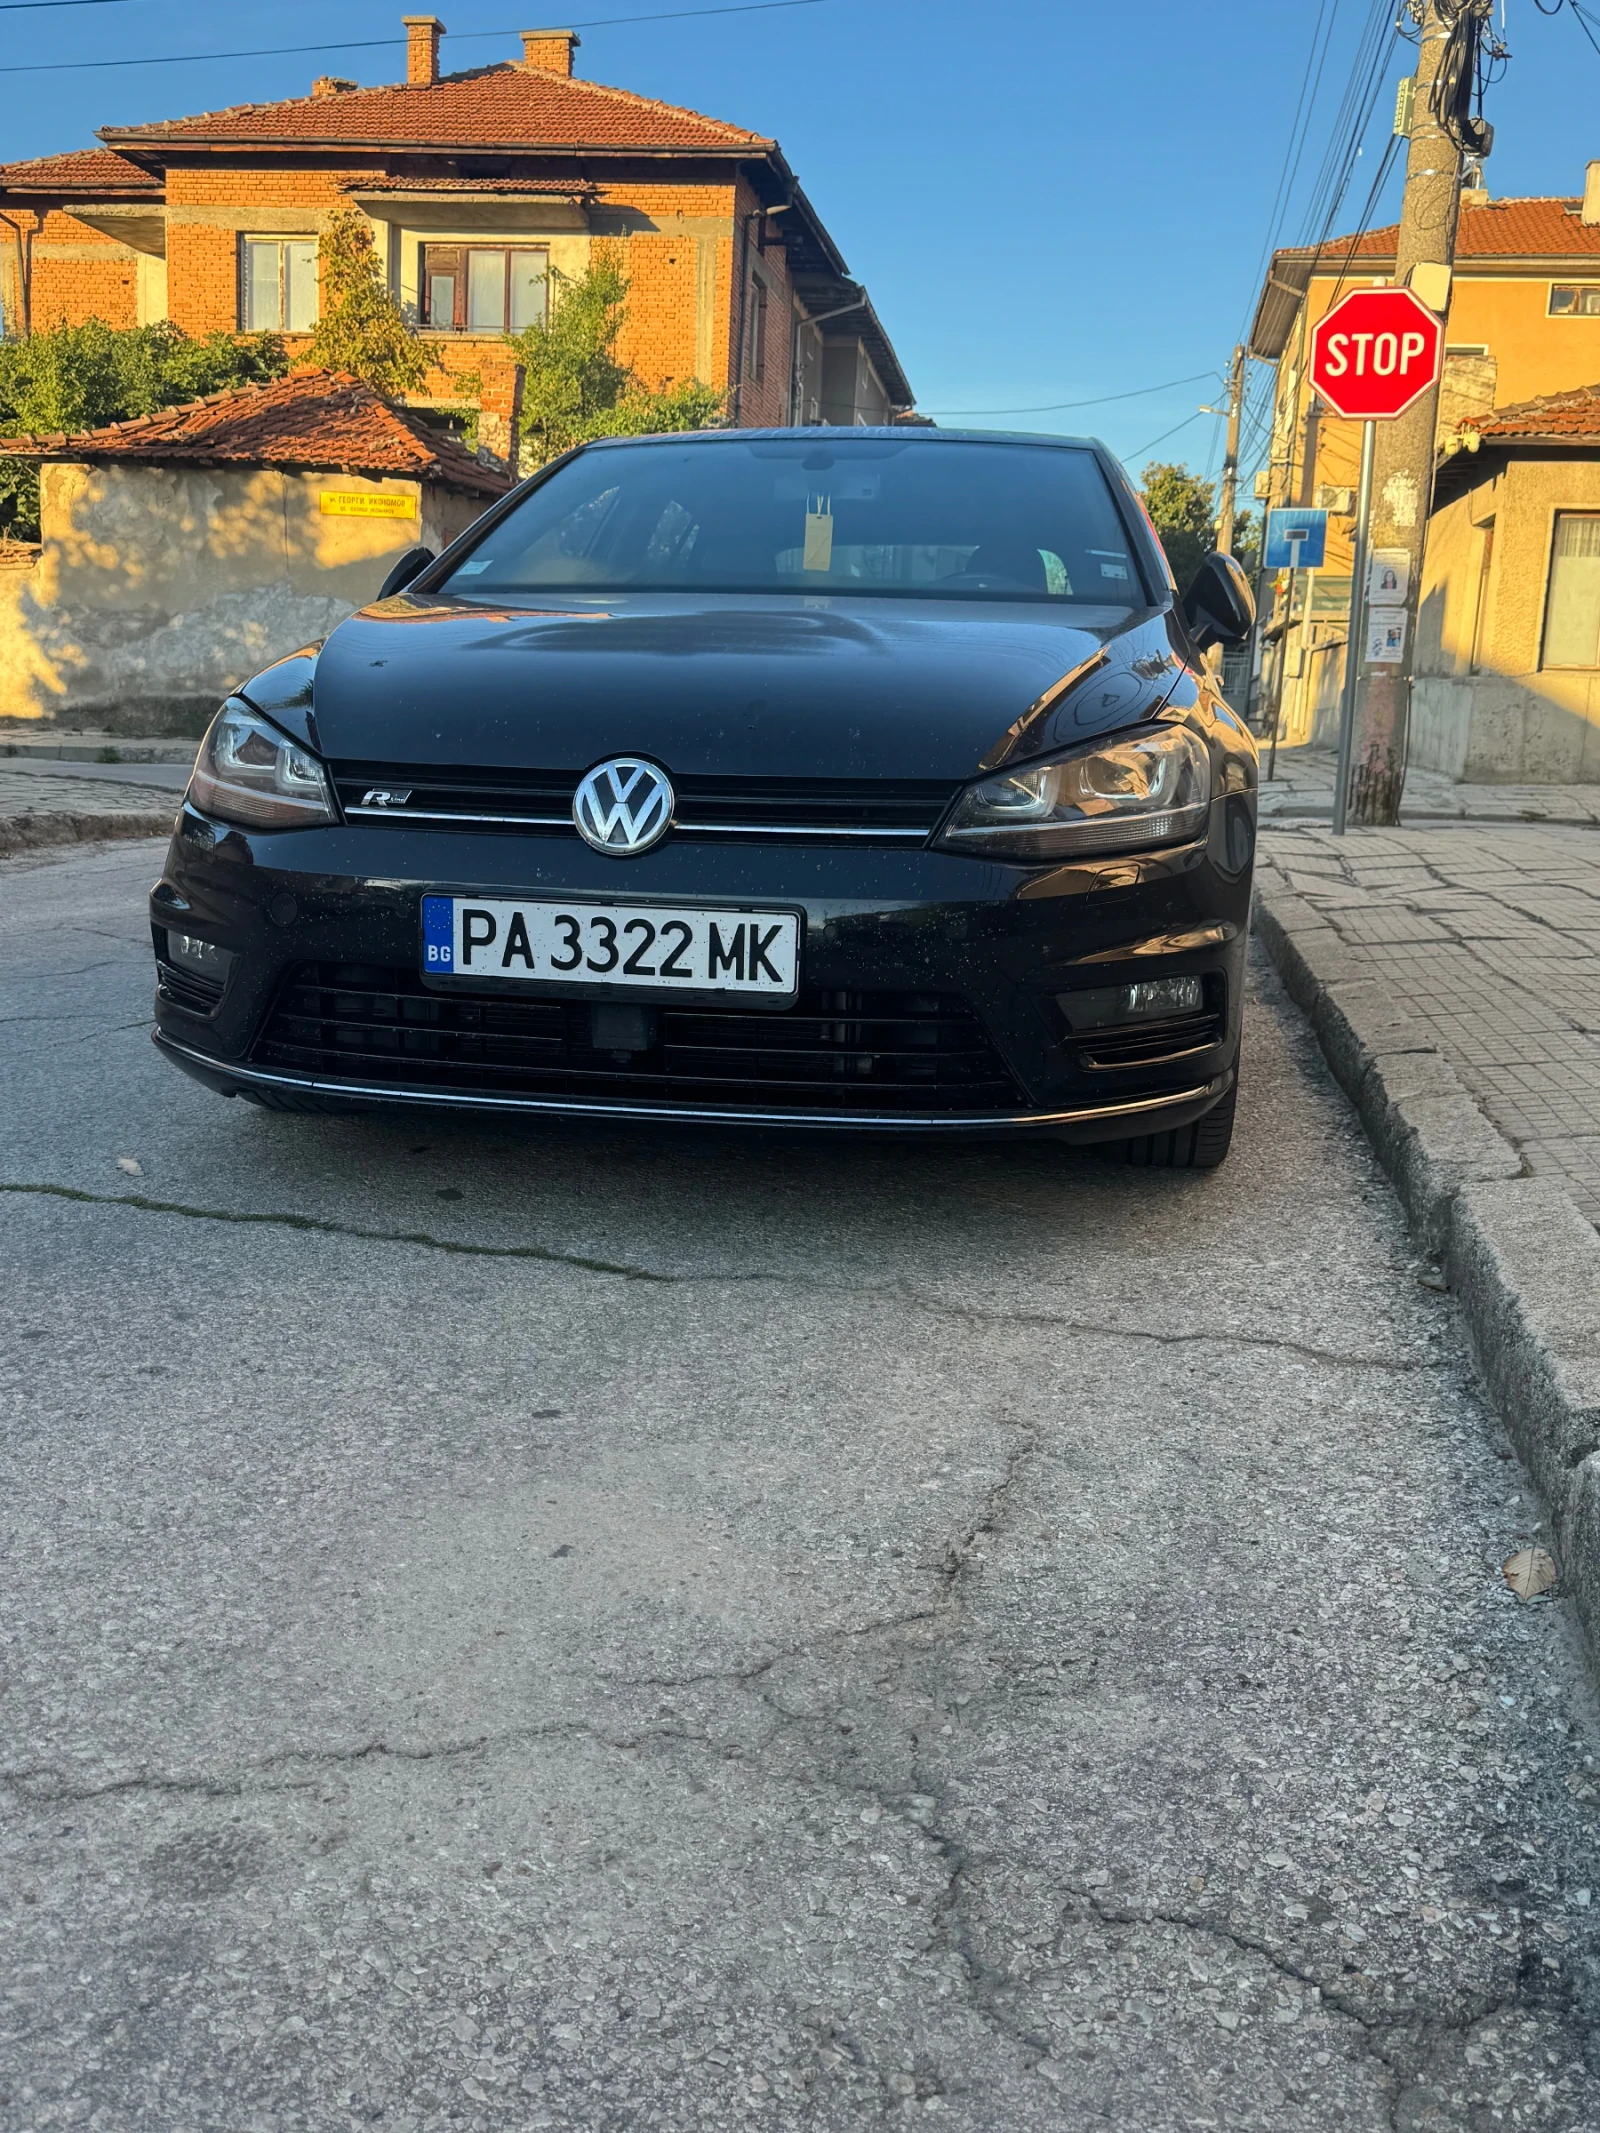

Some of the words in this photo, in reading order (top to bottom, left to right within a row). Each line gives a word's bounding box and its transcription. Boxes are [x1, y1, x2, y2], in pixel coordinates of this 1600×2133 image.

[1325, 332, 1425, 377] STOP
[338, 495, 365, 505] ГЕОРГИ
[368, 498, 406, 508] ИКОНОМОВ
[573, 758, 674, 855] VW
[427, 945, 452, 963] BG
[462, 909, 535, 969] PA
[550, 914, 693, 978] 3322
[708, 922, 784, 982] MK
